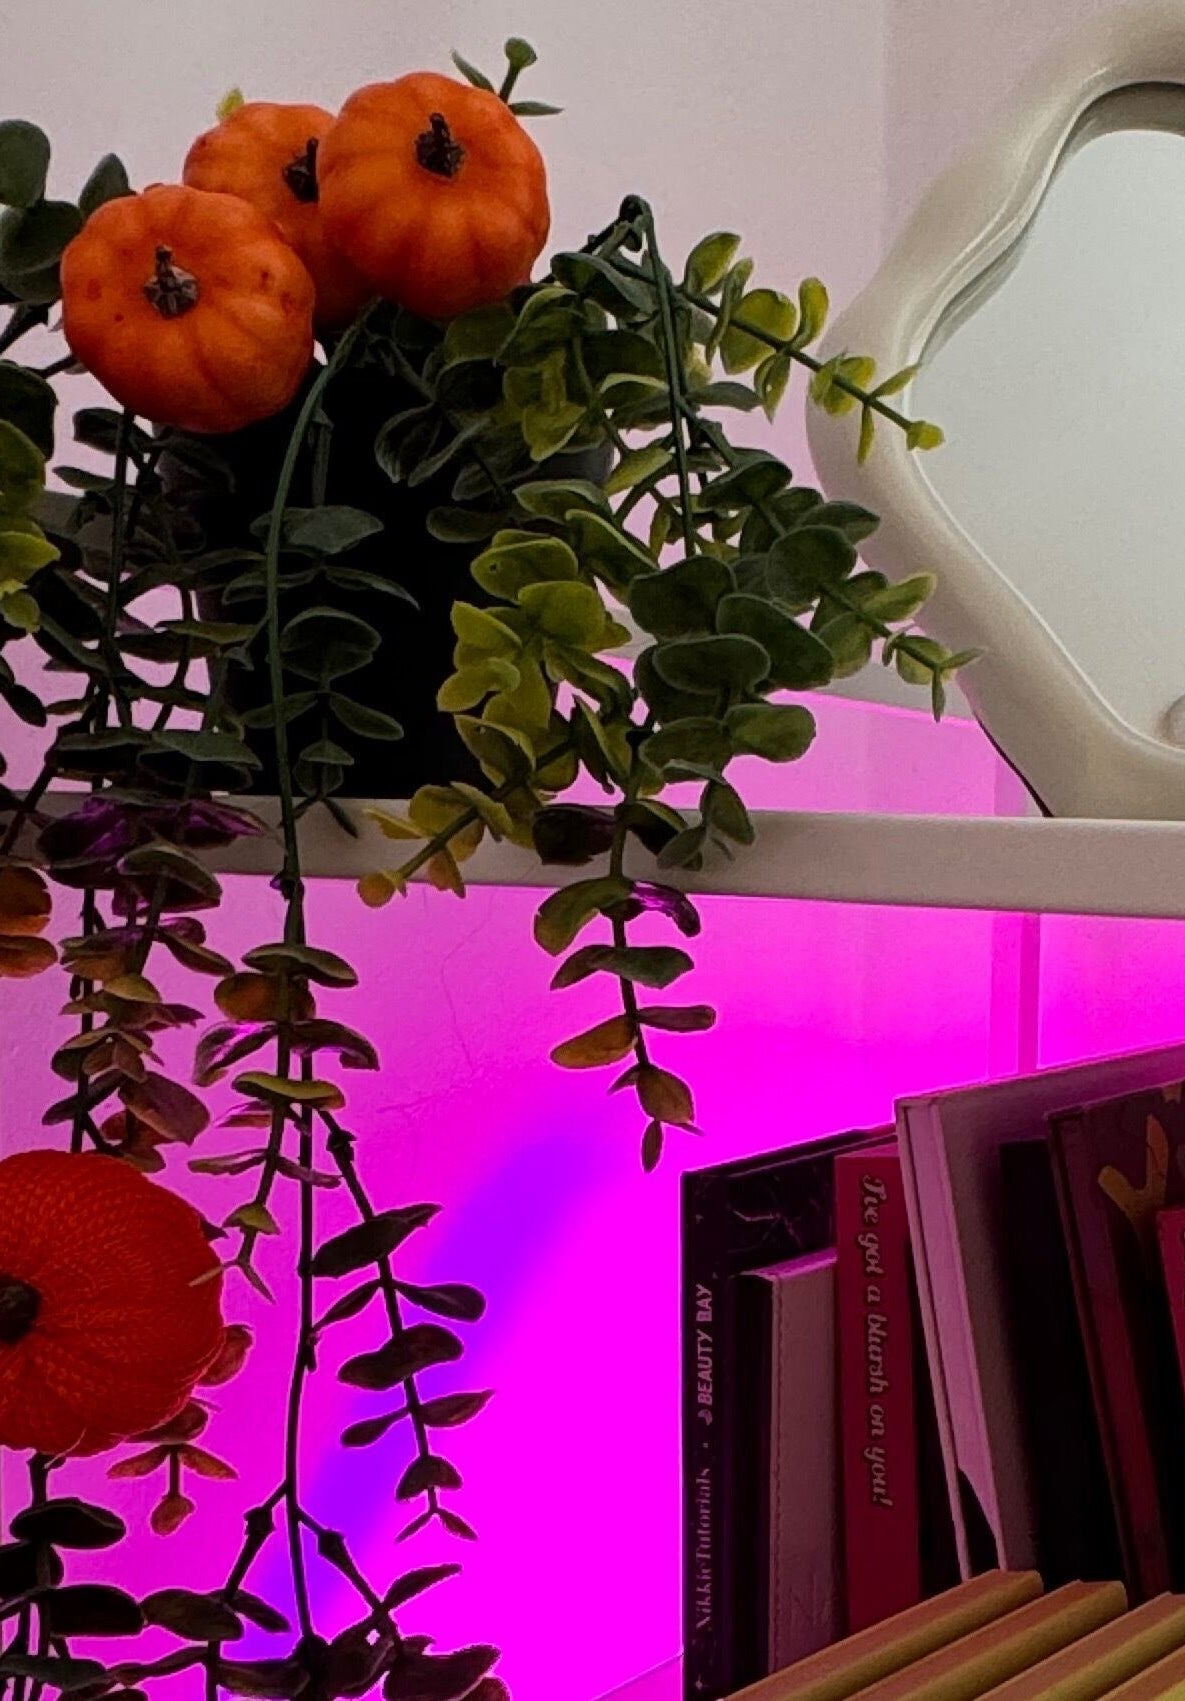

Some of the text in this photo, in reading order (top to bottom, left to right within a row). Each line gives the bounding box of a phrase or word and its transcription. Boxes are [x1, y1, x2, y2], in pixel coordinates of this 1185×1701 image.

[858, 1232, 887, 1274] got
[867, 1285, 881, 1302] a
[870, 1404, 887, 1436] on
[695, 1283, 713, 1631] NikkieTutorials BEAUTY BAY
[863, 1446, 893, 1506] you!
